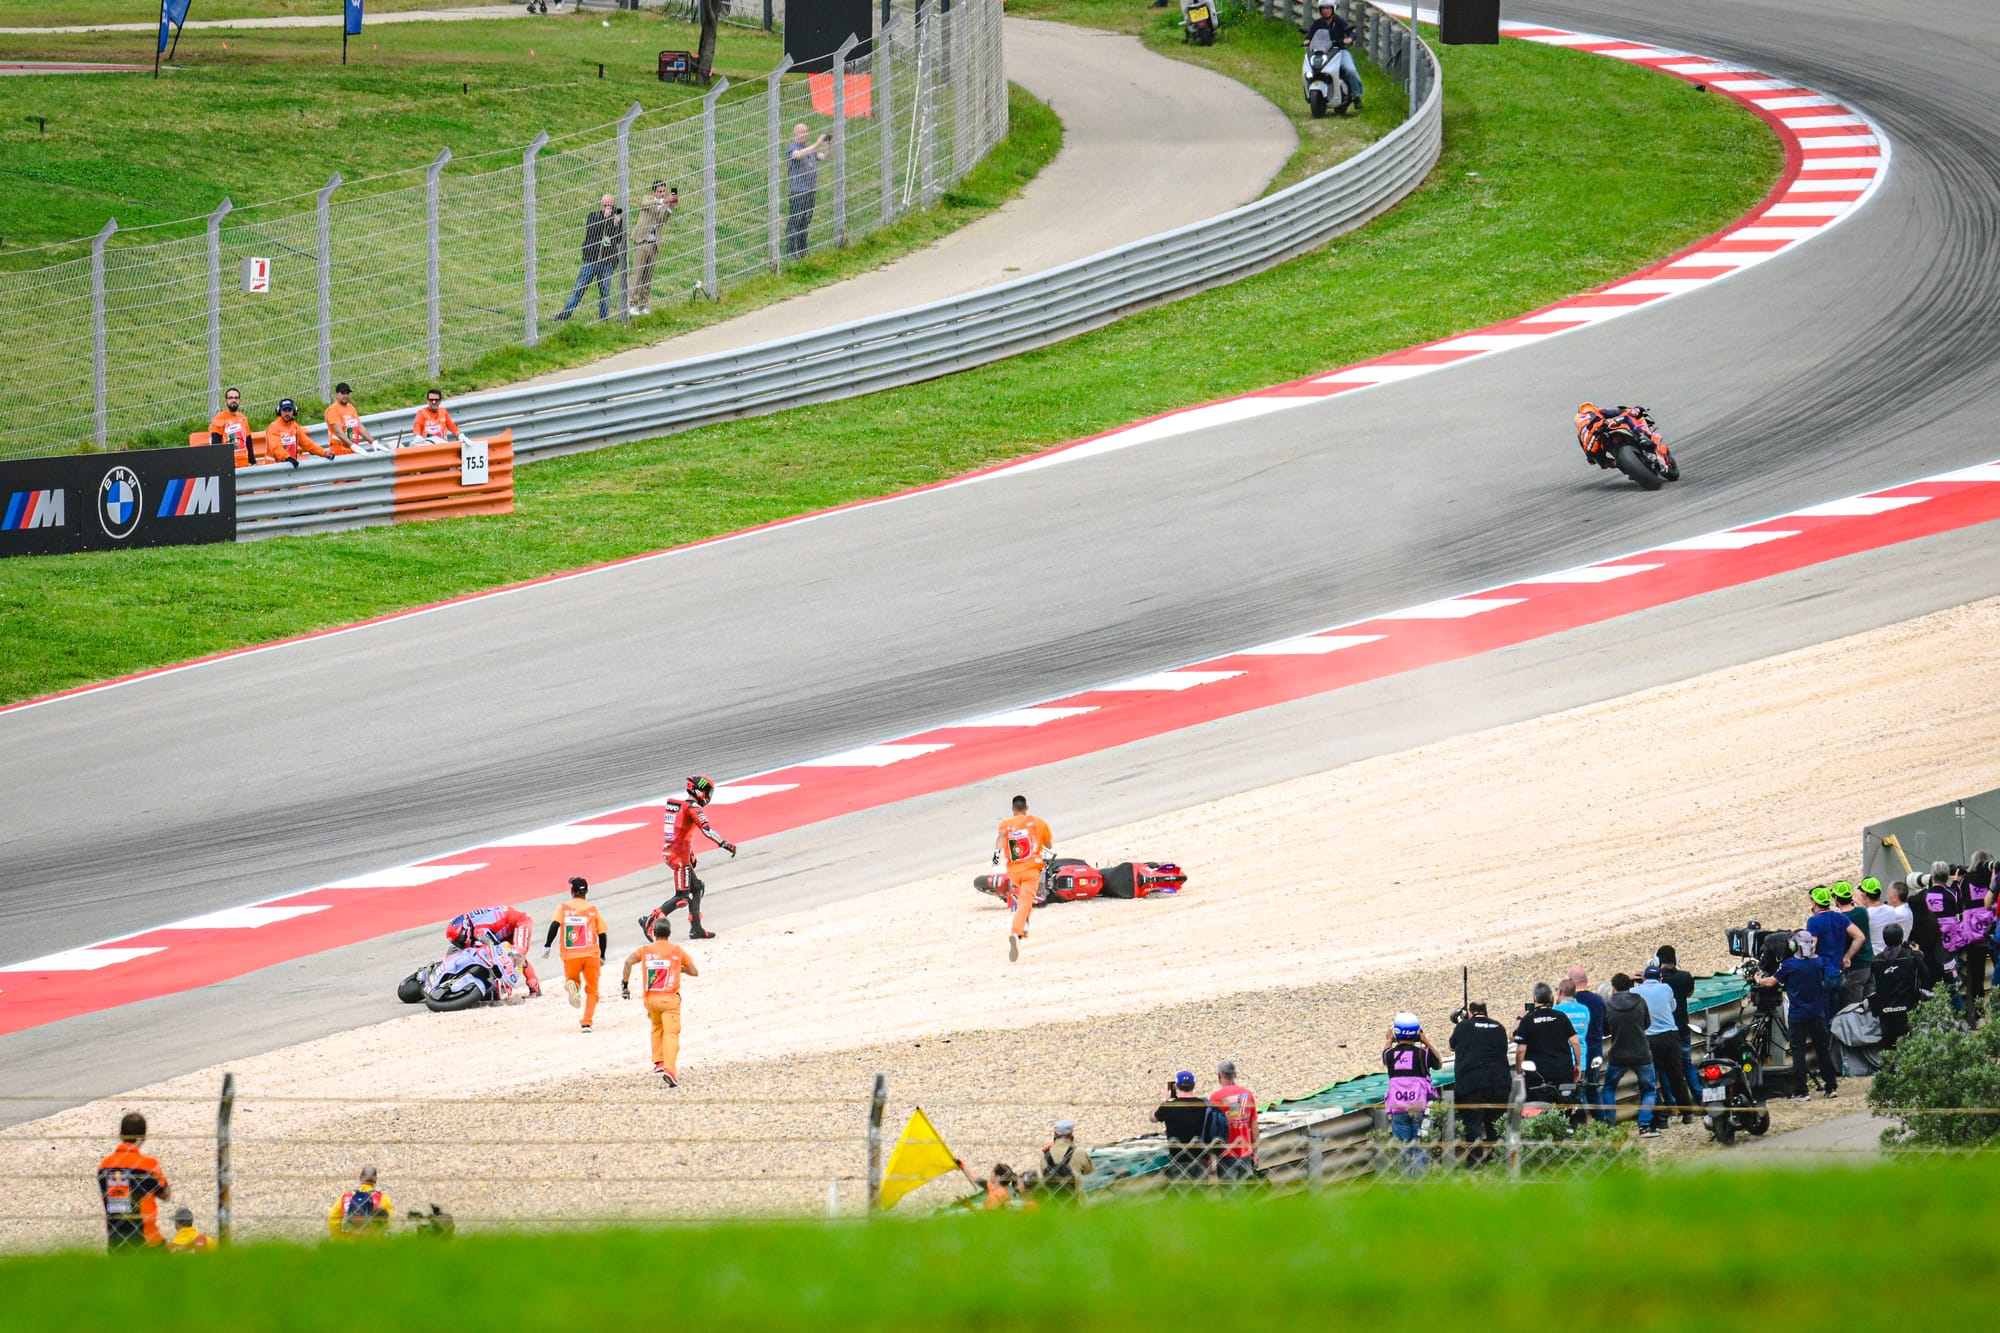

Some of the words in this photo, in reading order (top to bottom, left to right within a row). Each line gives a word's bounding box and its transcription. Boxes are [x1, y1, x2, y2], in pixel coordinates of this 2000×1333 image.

[466, 455, 485, 470] T5.5
[104, 469, 136, 490] BMW
[1395, 1090, 1416, 1102] 048
